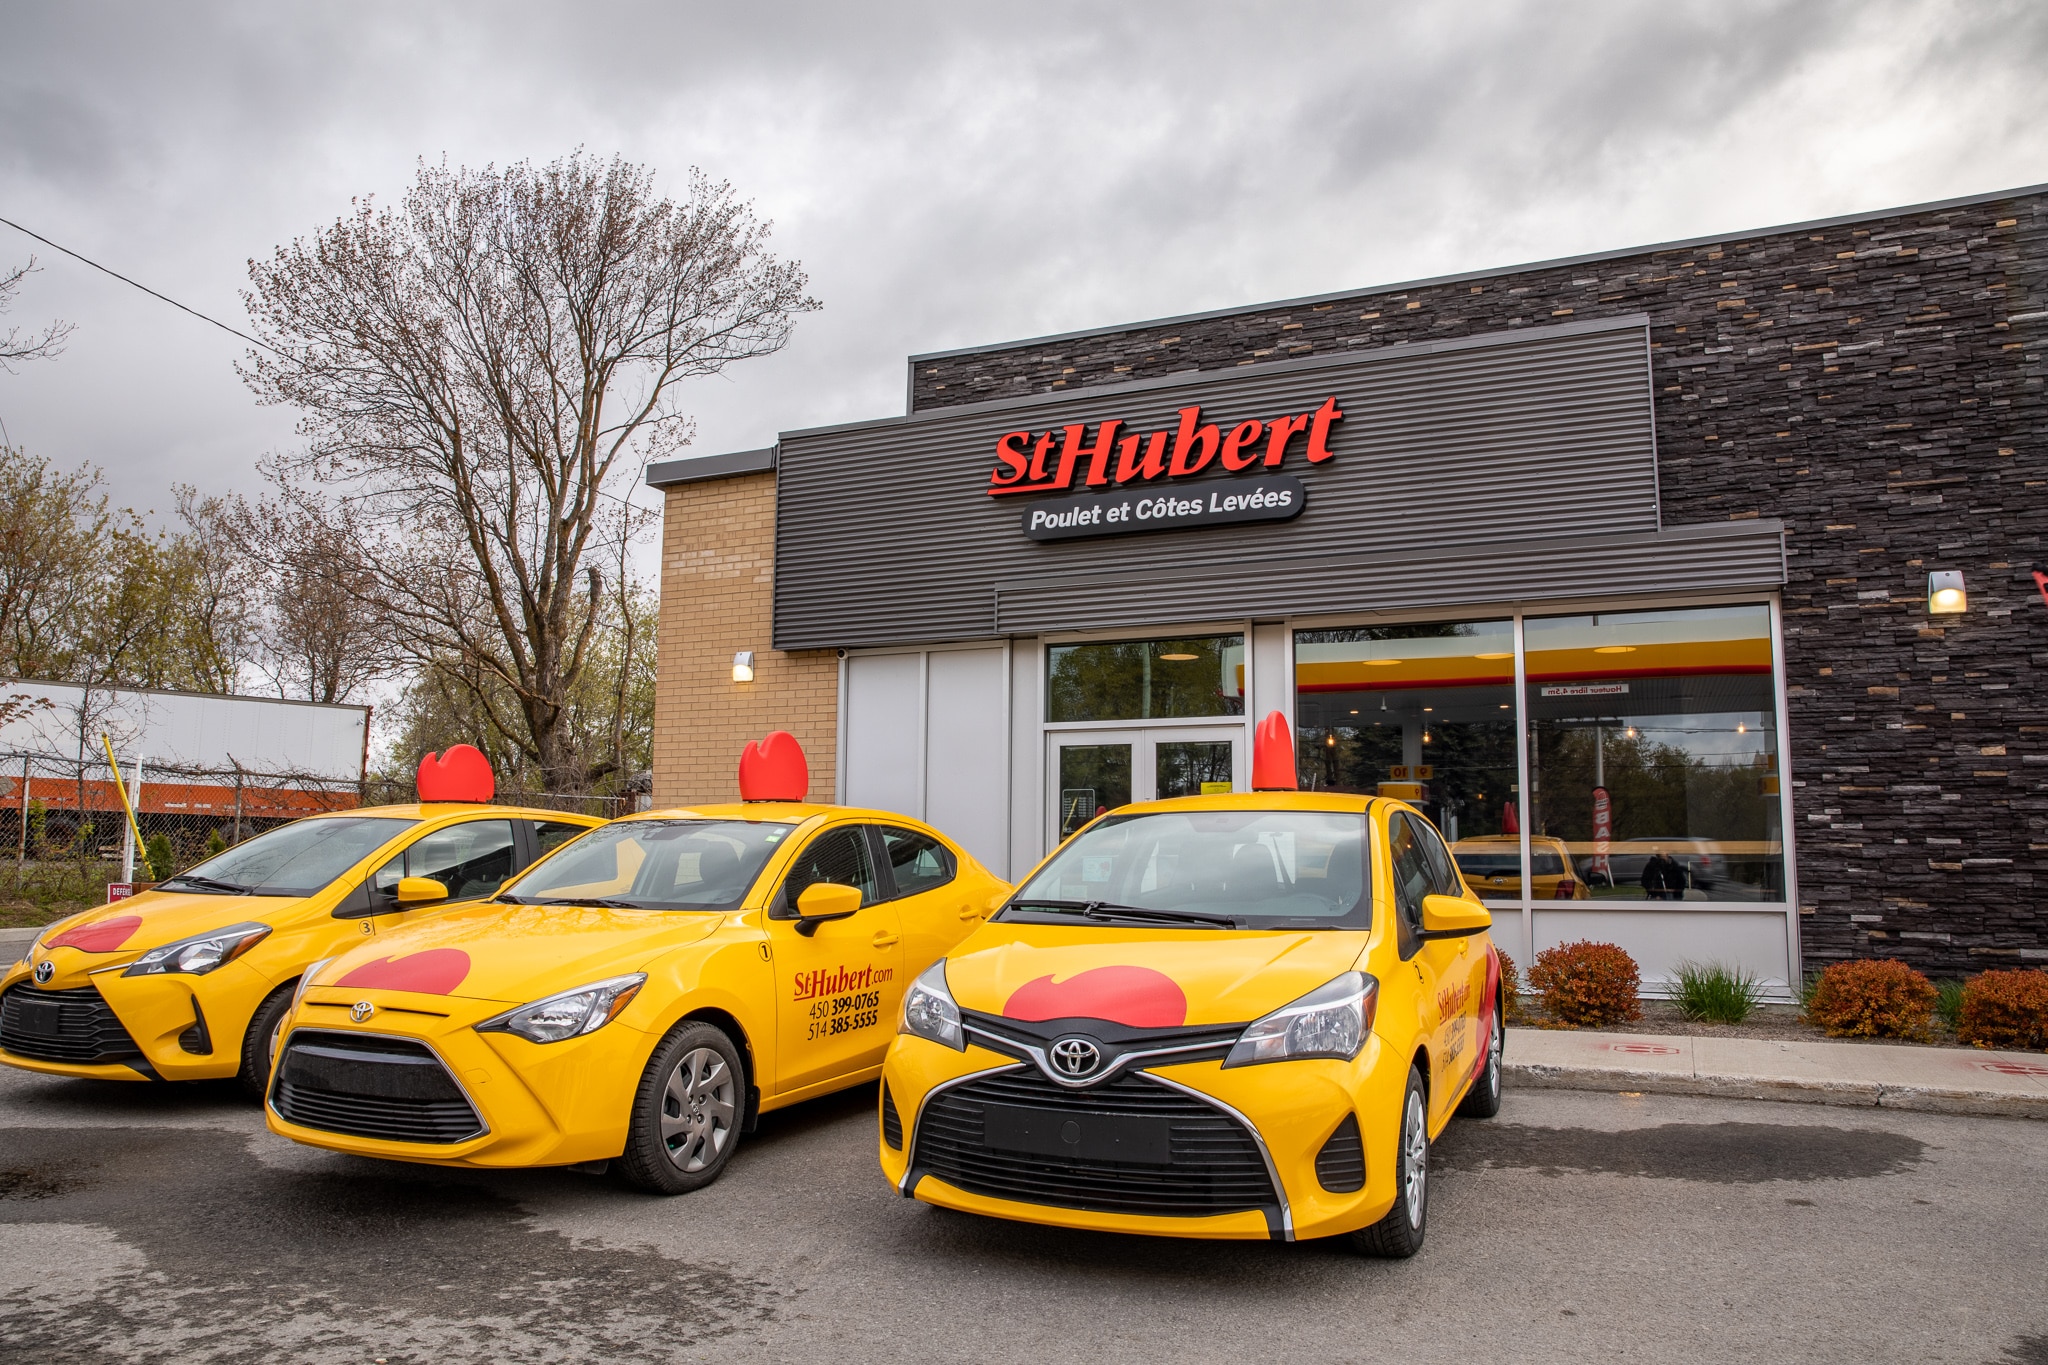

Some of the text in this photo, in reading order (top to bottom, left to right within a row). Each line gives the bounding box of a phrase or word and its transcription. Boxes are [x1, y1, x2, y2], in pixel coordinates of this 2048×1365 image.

[1030, 487, 1292, 531] Poulet et Côtes Levées
[809, 991, 879, 1020] 450 399-0765
[807, 1010, 878, 1041] 514 385-5555
